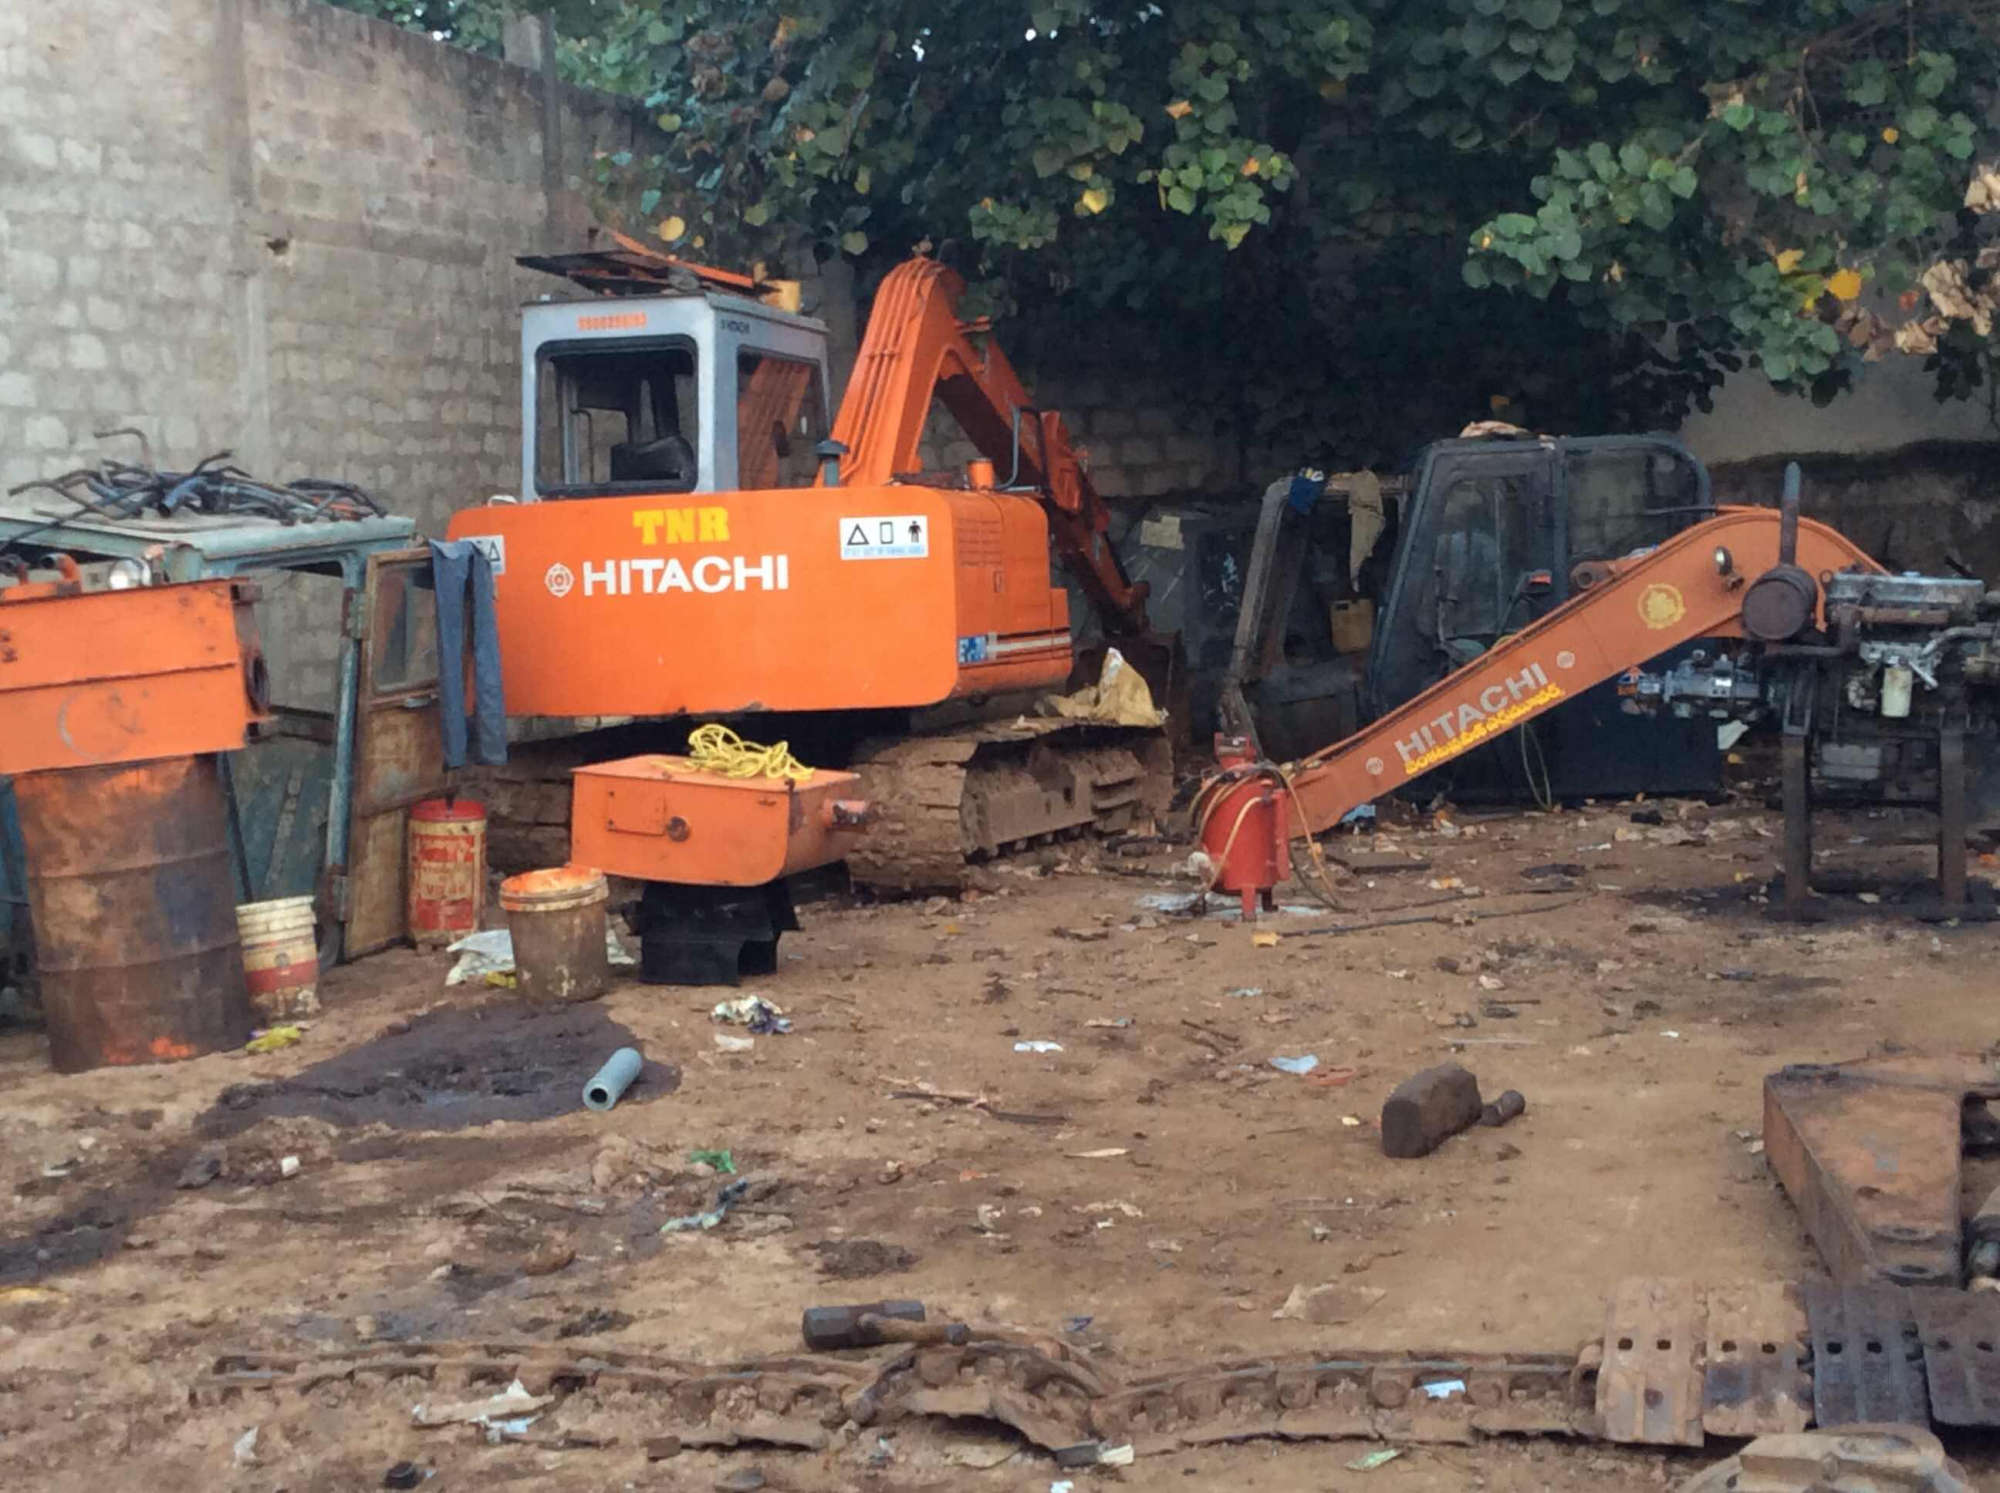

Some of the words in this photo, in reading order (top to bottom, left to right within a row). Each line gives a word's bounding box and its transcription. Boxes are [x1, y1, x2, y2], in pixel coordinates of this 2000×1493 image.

[632, 506, 730, 545] TNR
[582, 554, 789, 597] HITACHI
[1394, 662, 1548, 763] HITACHI
